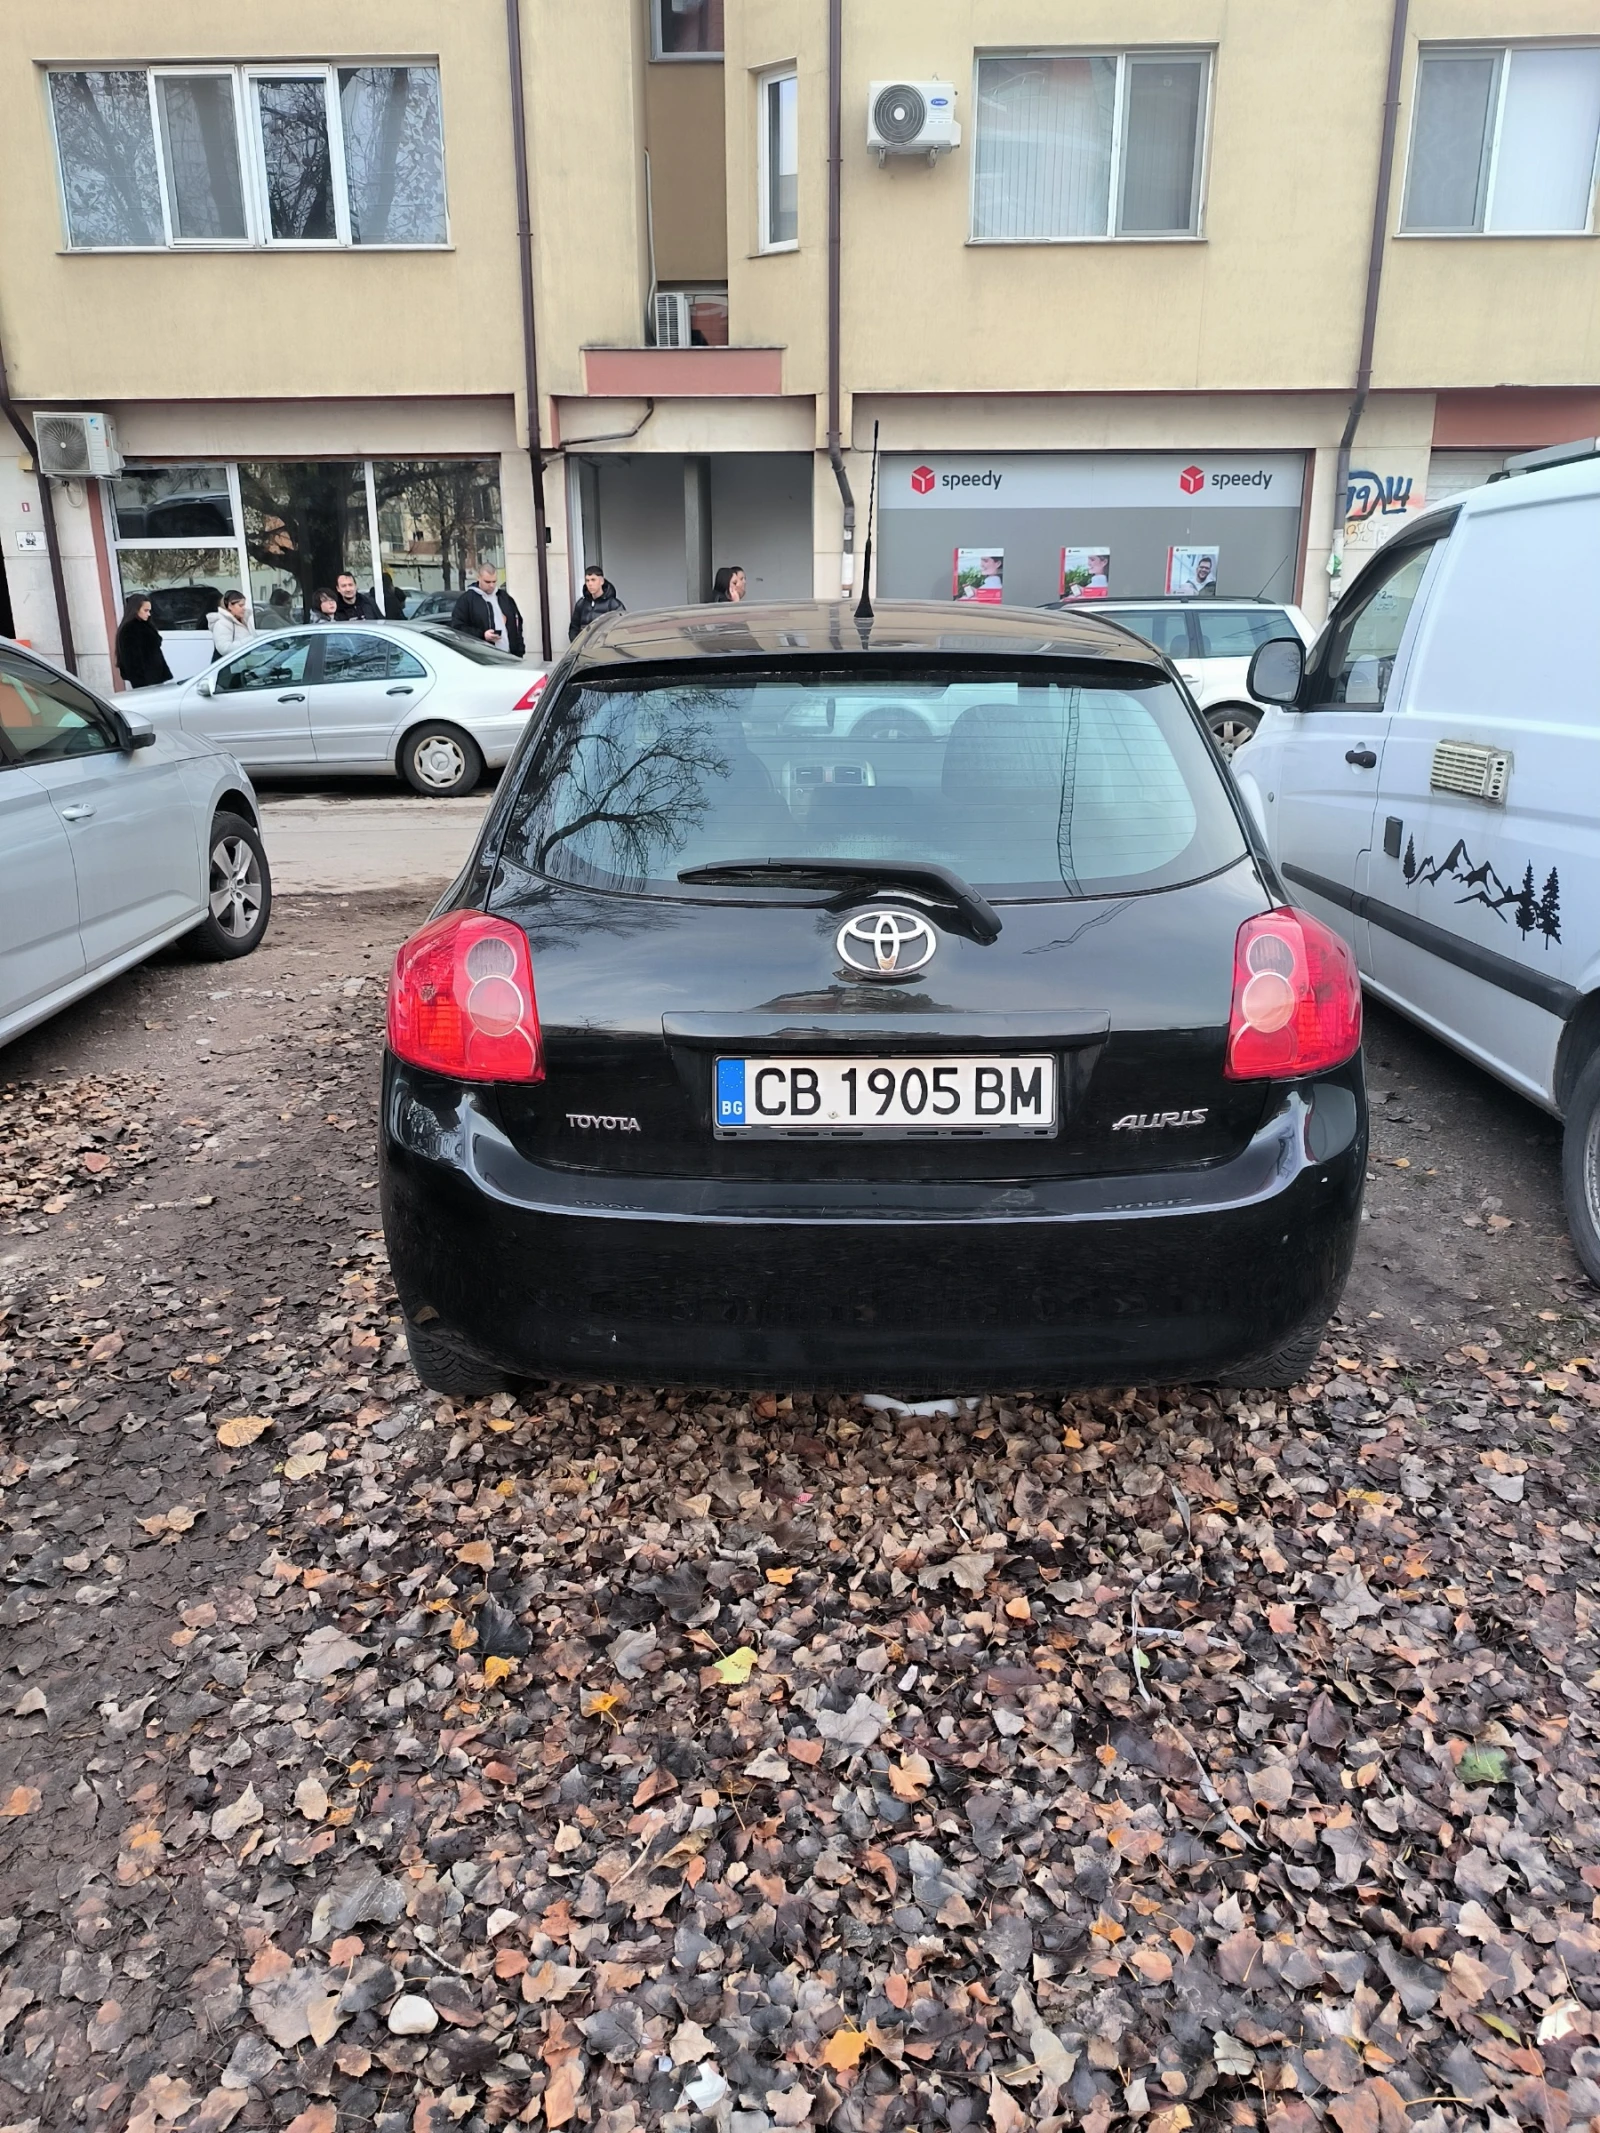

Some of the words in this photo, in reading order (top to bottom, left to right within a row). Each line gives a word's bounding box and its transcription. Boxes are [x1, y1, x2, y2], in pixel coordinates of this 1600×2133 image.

[942, 469, 1002, 490] speedy
[1211, 470, 1273, 490] speedy
[755, 1067, 822, 1116] CB
[841, 1067, 960, 1116] 1905
[975, 1067, 1042, 1115] BM
[722, 1101, 743, 1115] BG
[565, 1114, 641, 1131] TOYOTA
[1112, 1108, 1209, 1130] AURIS
